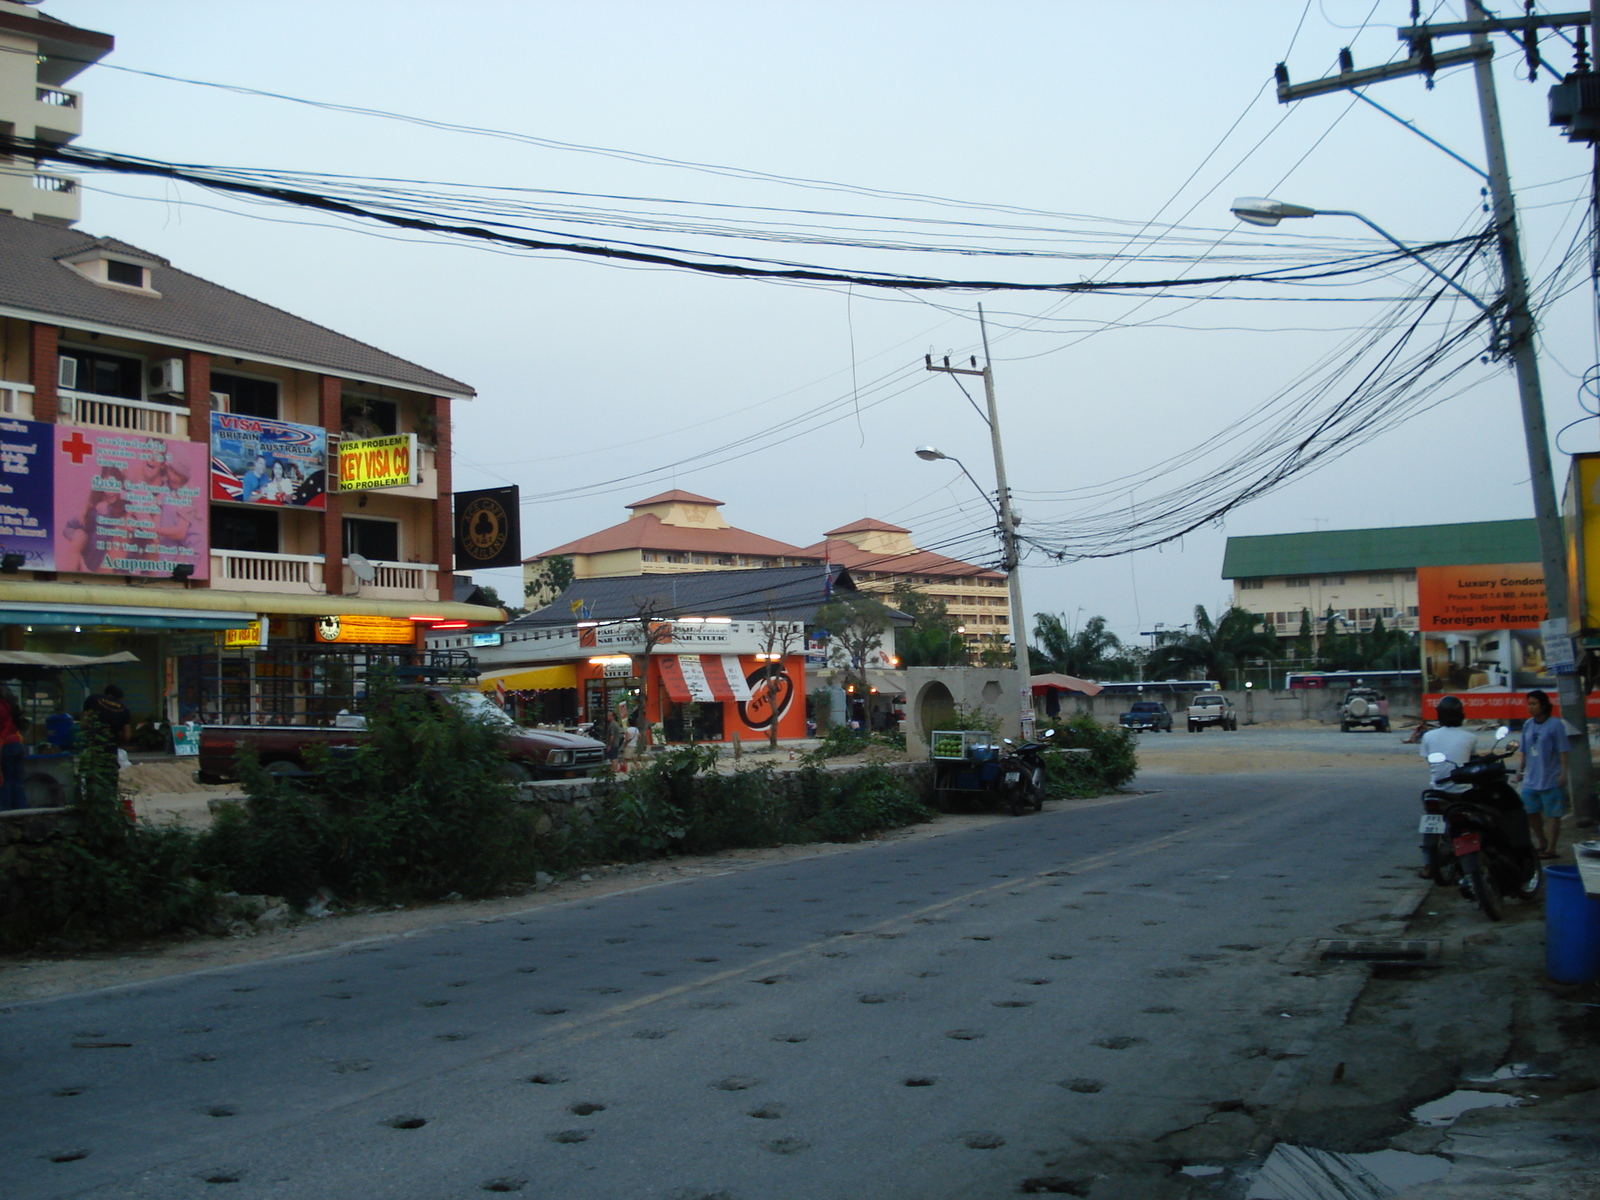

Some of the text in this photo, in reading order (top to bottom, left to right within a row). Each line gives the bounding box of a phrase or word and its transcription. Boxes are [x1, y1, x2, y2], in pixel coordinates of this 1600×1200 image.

[219, 415, 263, 433] VISA
[219, 430, 259, 441] BRITAIN
[260, 443, 313, 455] AUSTRALIA
[340, 436, 409, 451] VISA PROBLEM ?
[340, 446, 409, 482] KEY VISA CO
[340, 482, 354, 491] NO
[356, 477, 399, 490] PROBLEM
[96, 515, 155, 528] General Practice
[464, 532, 505, 558] THAILAND
[101, 554, 178, 573] Acupunctu
[1458, 576, 1546, 589] Luxury Condom
[1447, 593, 1468, 601] Price
[1469, 592, 1488, 600] Start
[1451, 605, 1474, 614] Types
[1480, 603, 1517, 612] Standard
[1522, 602, 1540, 611] Suit
[1433, 613, 1497, 626] Foreigner
[1500, 612, 1539, 624] Name
